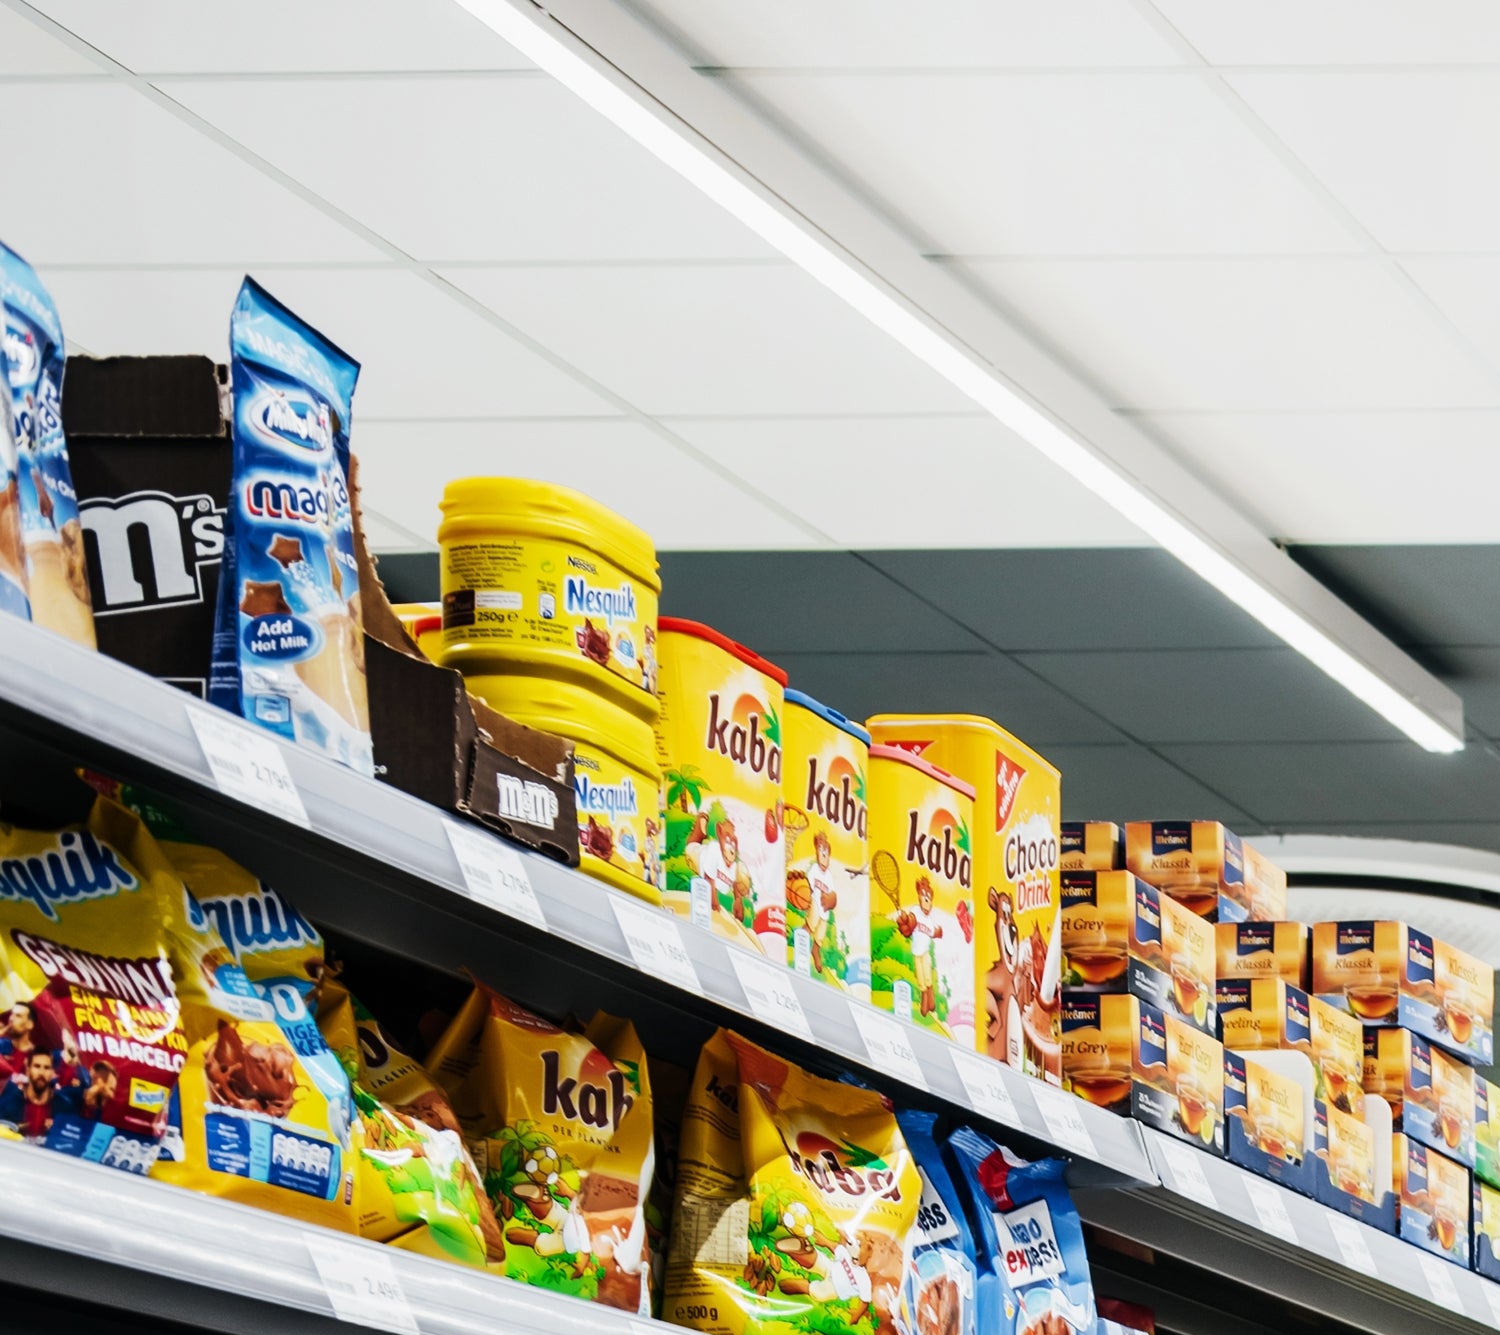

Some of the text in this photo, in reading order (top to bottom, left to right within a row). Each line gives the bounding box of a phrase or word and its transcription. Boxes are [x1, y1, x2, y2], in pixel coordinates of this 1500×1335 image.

[567, 578, 636, 627] Nesquik
[477, 611, 505, 623] 250g
[257, 619, 293, 637] Add
[251, 635, 308, 653] Hot Milk
[707, 694, 781, 784] kaba
[807, 758, 867, 840] kaba
[908, 811, 971, 887] kaba
[1006, 834, 1056, 880] Choco
[1151, 858, 1190, 869] Klassik
[1017, 875, 1050, 911] Drink
[1073, 919, 1103, 931] Grey
[1234, 959, 1273, 969] Klassik
[1334, 958, 1374, 970] Klassik
[70, 986, 103, 1010] EIN
[78, 1033, 101, 1053] IN
[1077, 1042, 1107, 1055] Grey
[687, 1304, 709, 1320] 500
